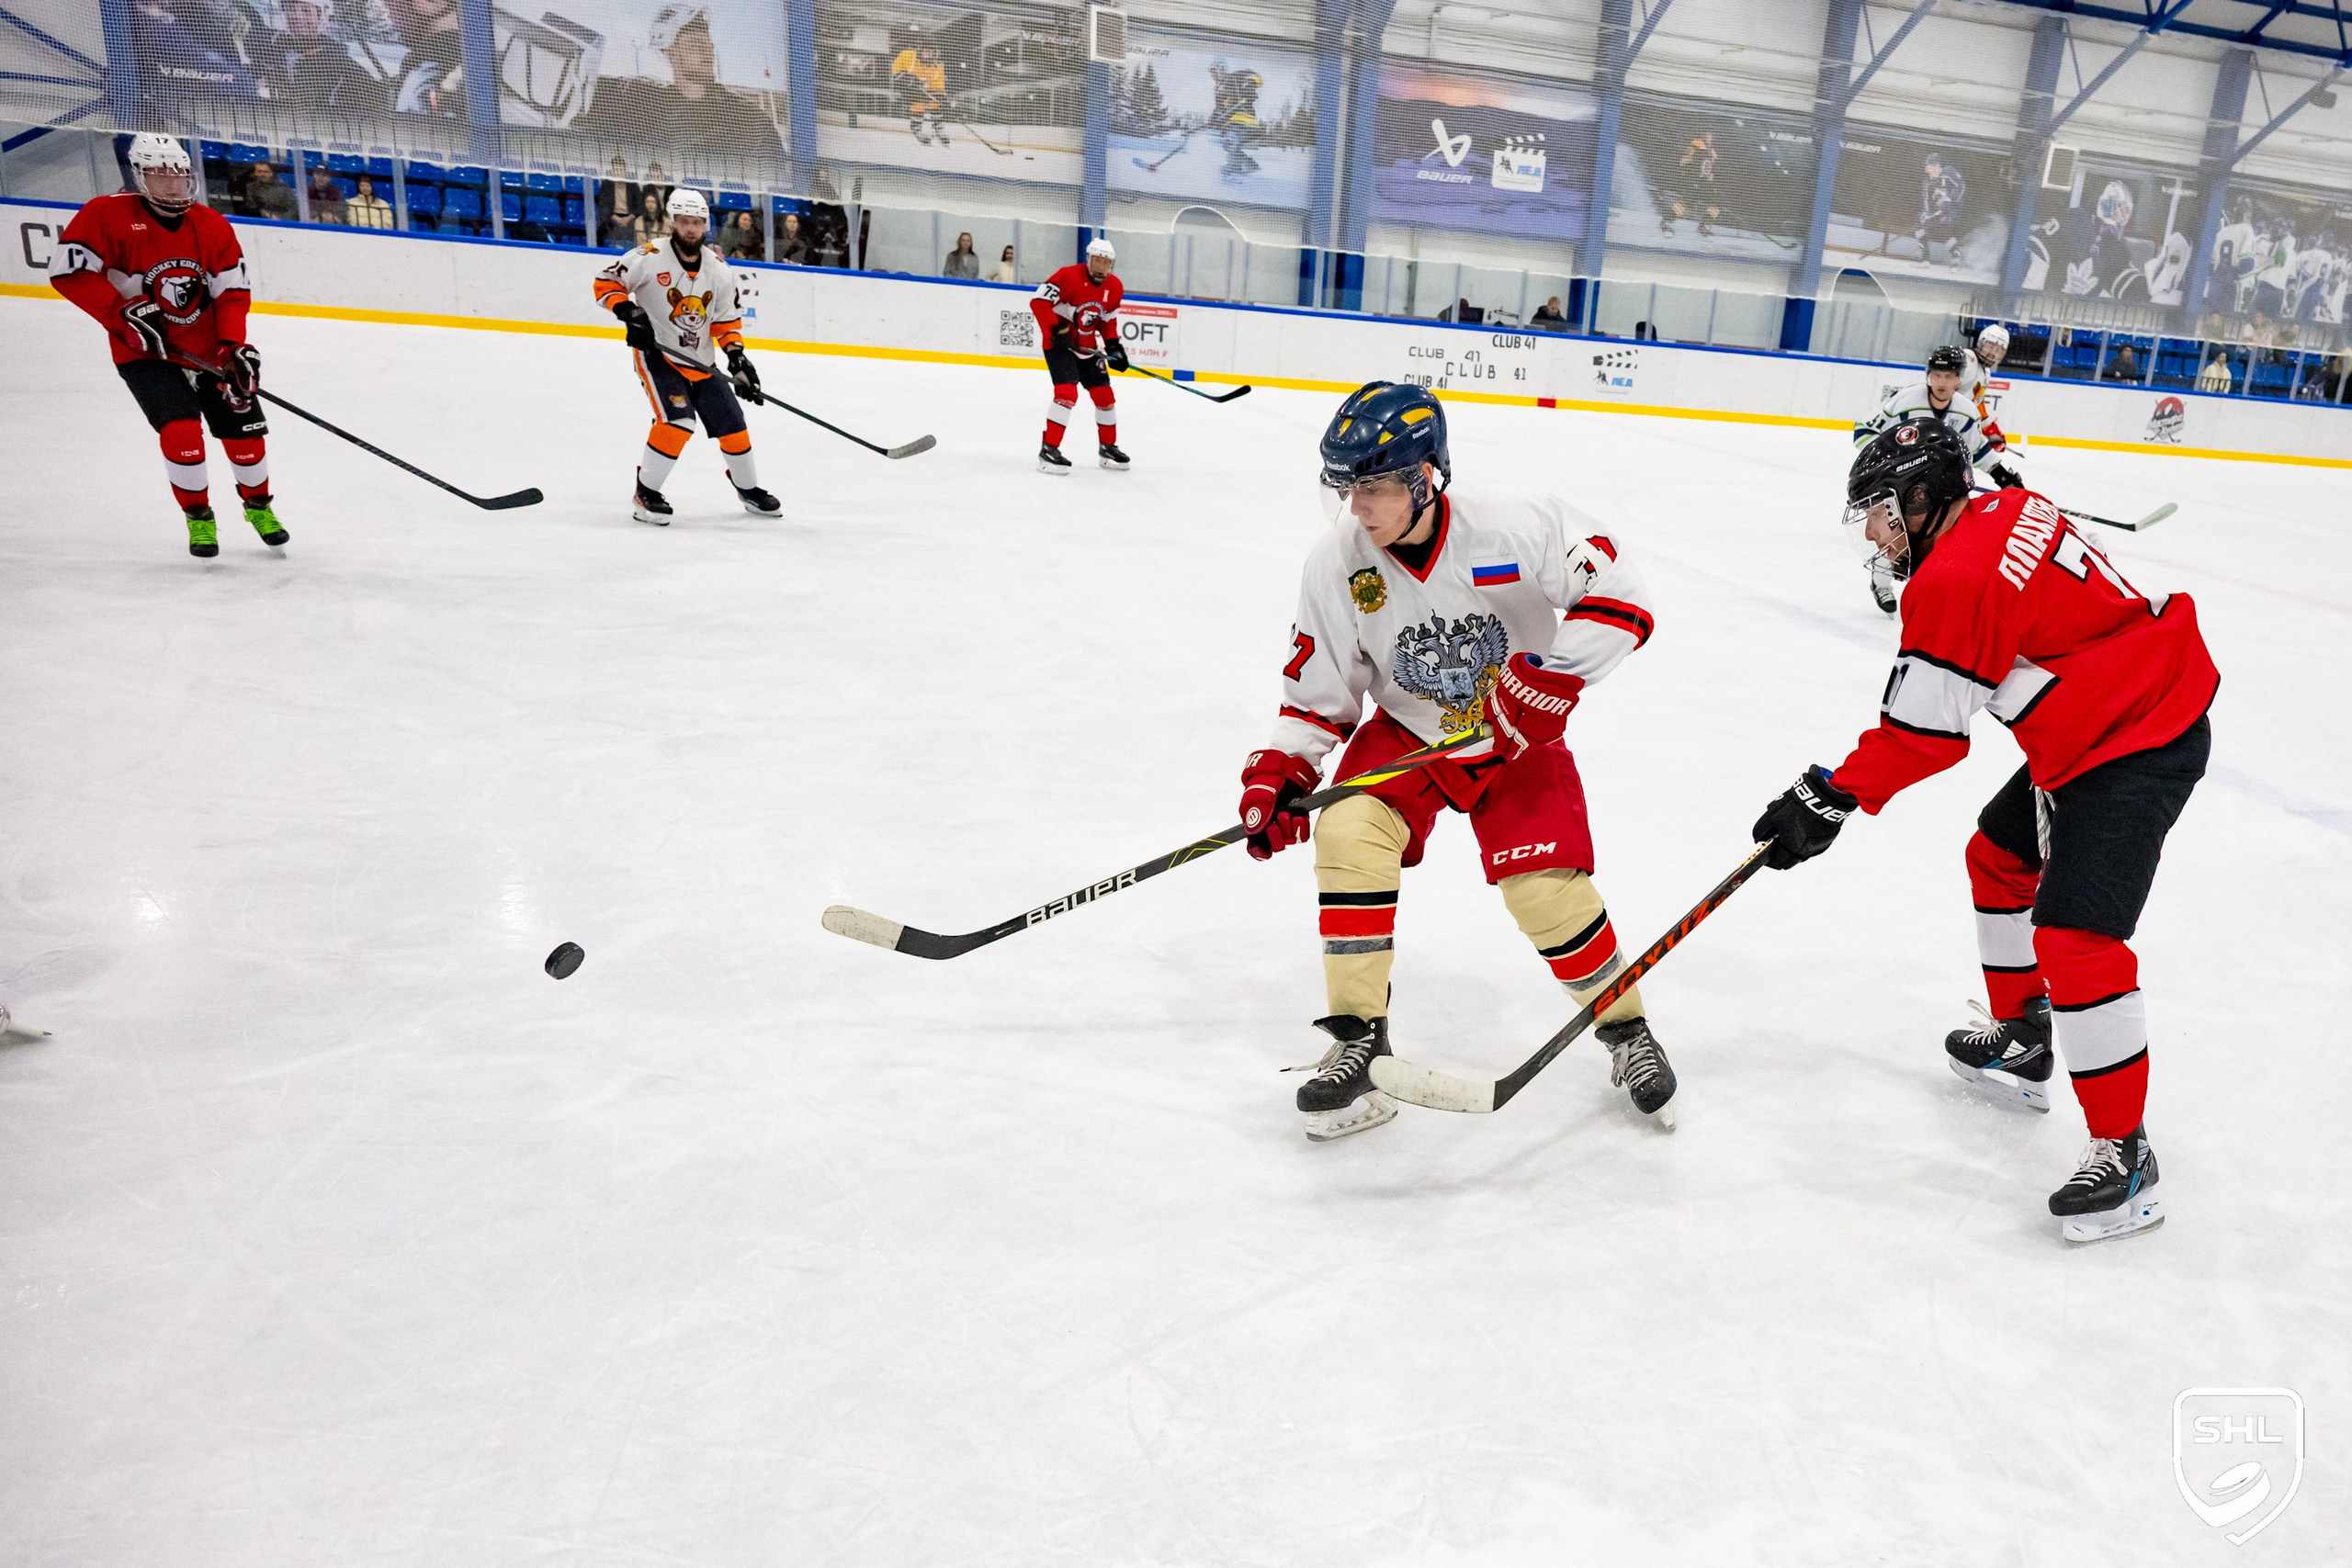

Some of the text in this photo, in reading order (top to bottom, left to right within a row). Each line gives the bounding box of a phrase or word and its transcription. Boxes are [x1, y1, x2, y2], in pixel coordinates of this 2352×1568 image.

[1417, 170, 1474, 184] BAUER
[68, 248, 88, 270] 17
[144, 260, 177, 285] HOCKEY
[1044, 285, 1059, 304] 72
[1119, 321, 1169, 343] OFT
[1492, 334, 1536, 350] CLUB 41
[1408, 346, 1480, 362] CLUB 41
[1446, 362, 1526, 380] CLUB 41
[1437, 377, 1448, 389] 41
[1412, 425, 1431, 440] Reebok
[1326, 460, 1351, 472] Reebok
[1896, 455, 1928, 473] BAUER
[1498, 666, 1573, 716] ARRIOR
[1492, 841, 1557, 865] CCM
[1026, 868, 1137, 928] BAUER
[1593, 899, 1711, 1020] SOYUZ
